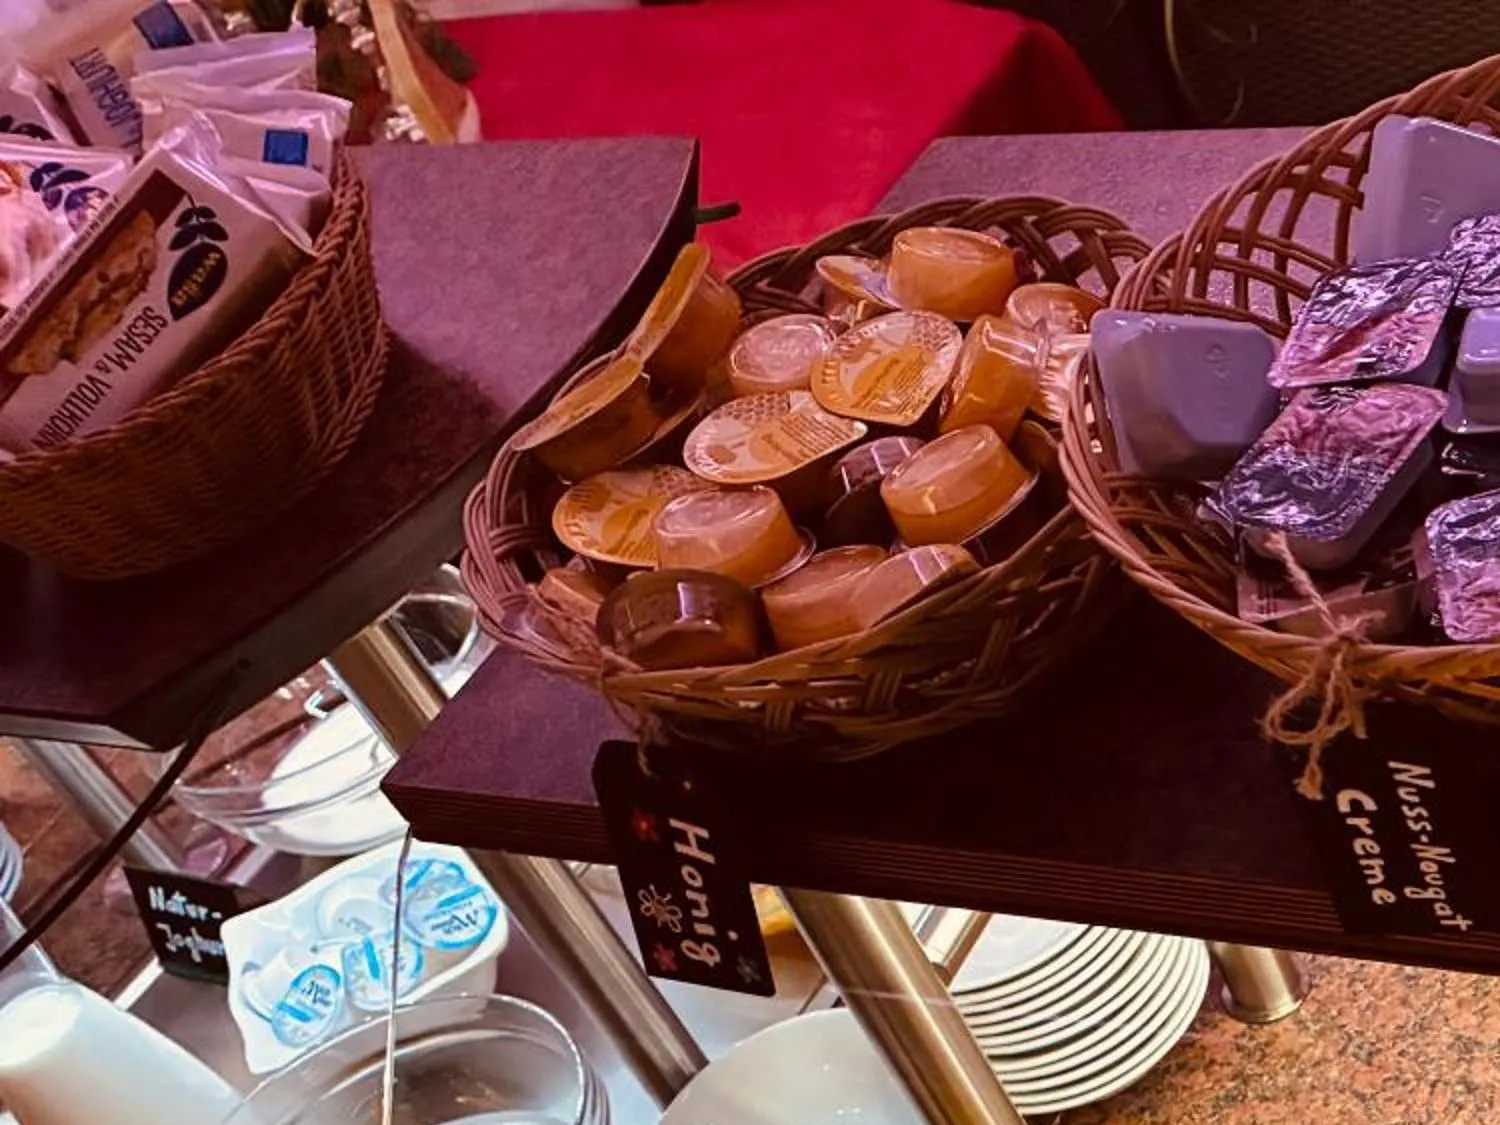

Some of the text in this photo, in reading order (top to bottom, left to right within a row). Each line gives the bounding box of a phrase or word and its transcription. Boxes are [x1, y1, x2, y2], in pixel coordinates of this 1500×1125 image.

[68, 46, 142, 128] JOGHURT
[172, 250, 221, 306] wasa
[103, 306, 169, 372] SESAM
[30, 373, 113, 450] VOLLKORN
[1336, 788, 1398, 905] Creme
[1387, 759, 1473, 932] Nuss-Nougat
[668, 817, 740, 968] Honig
